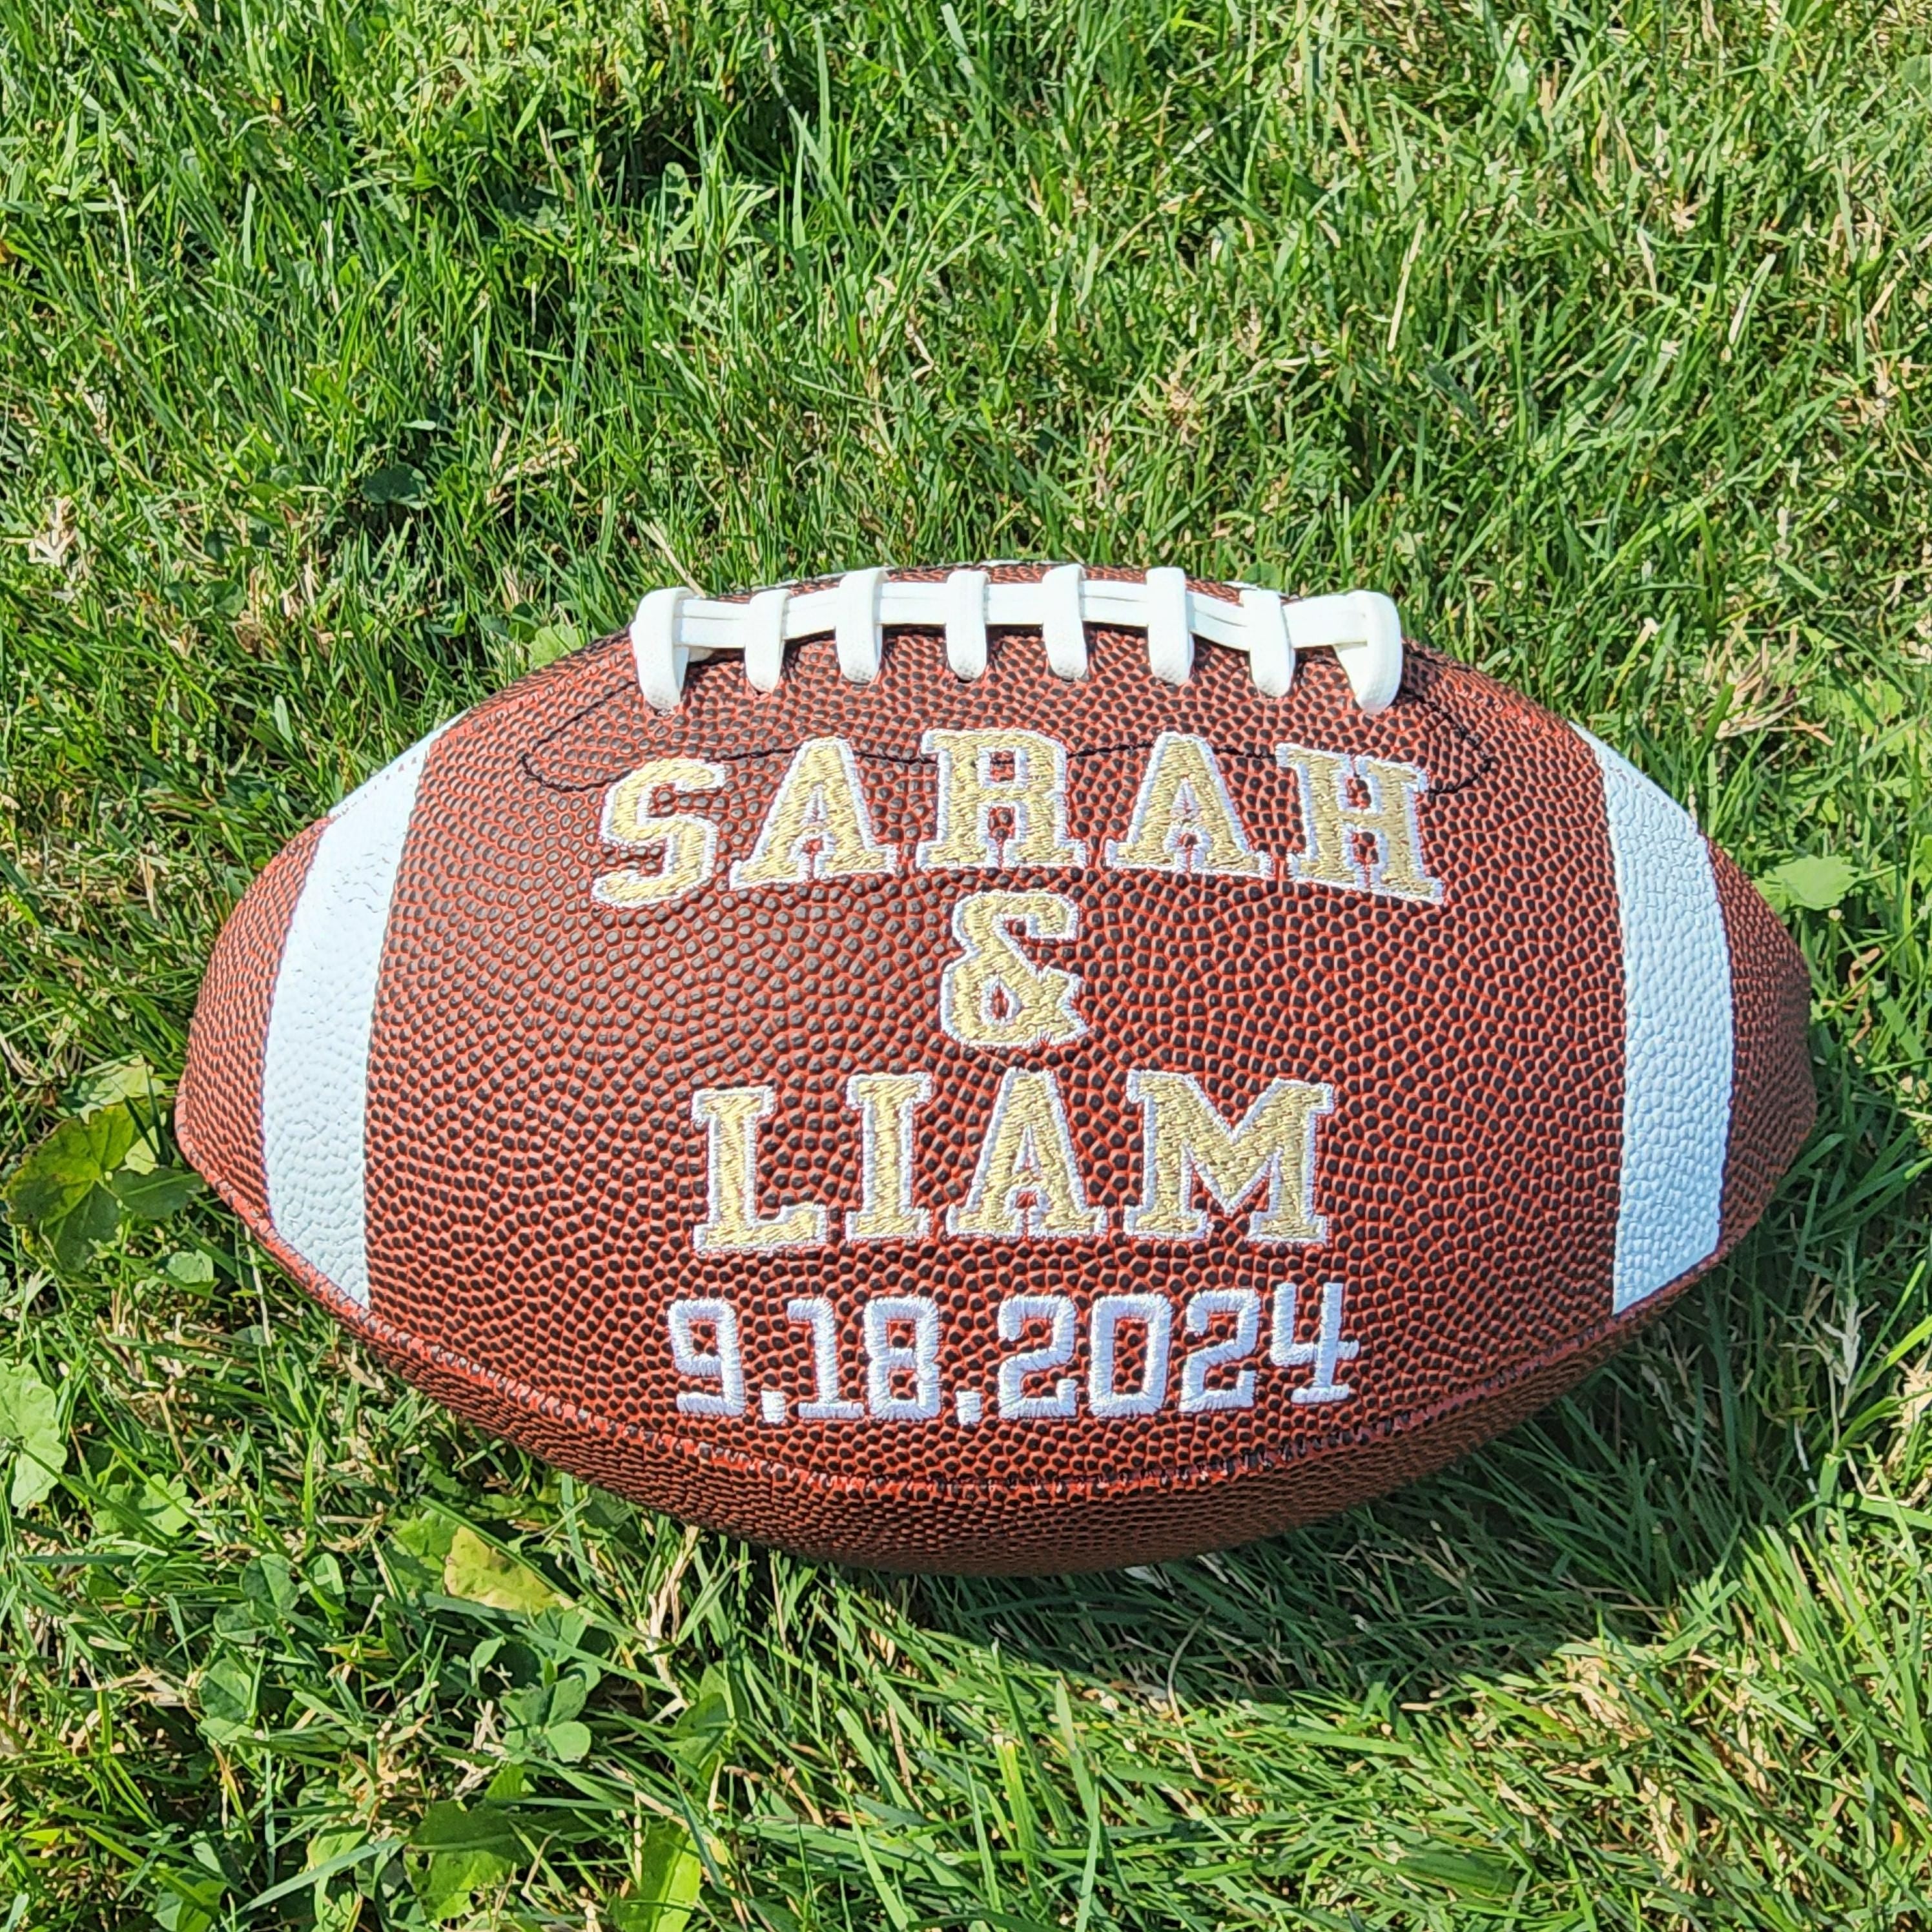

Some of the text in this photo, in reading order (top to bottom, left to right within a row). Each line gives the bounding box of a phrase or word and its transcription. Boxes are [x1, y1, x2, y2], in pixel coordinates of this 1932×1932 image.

[591, 727, 1445, 910] SARAH
[940, 888, 1090, 1051] &
[691, 1067, 1337, 1257] LIAM
[666, 1282, 1360, 1424] 9.18.2024
